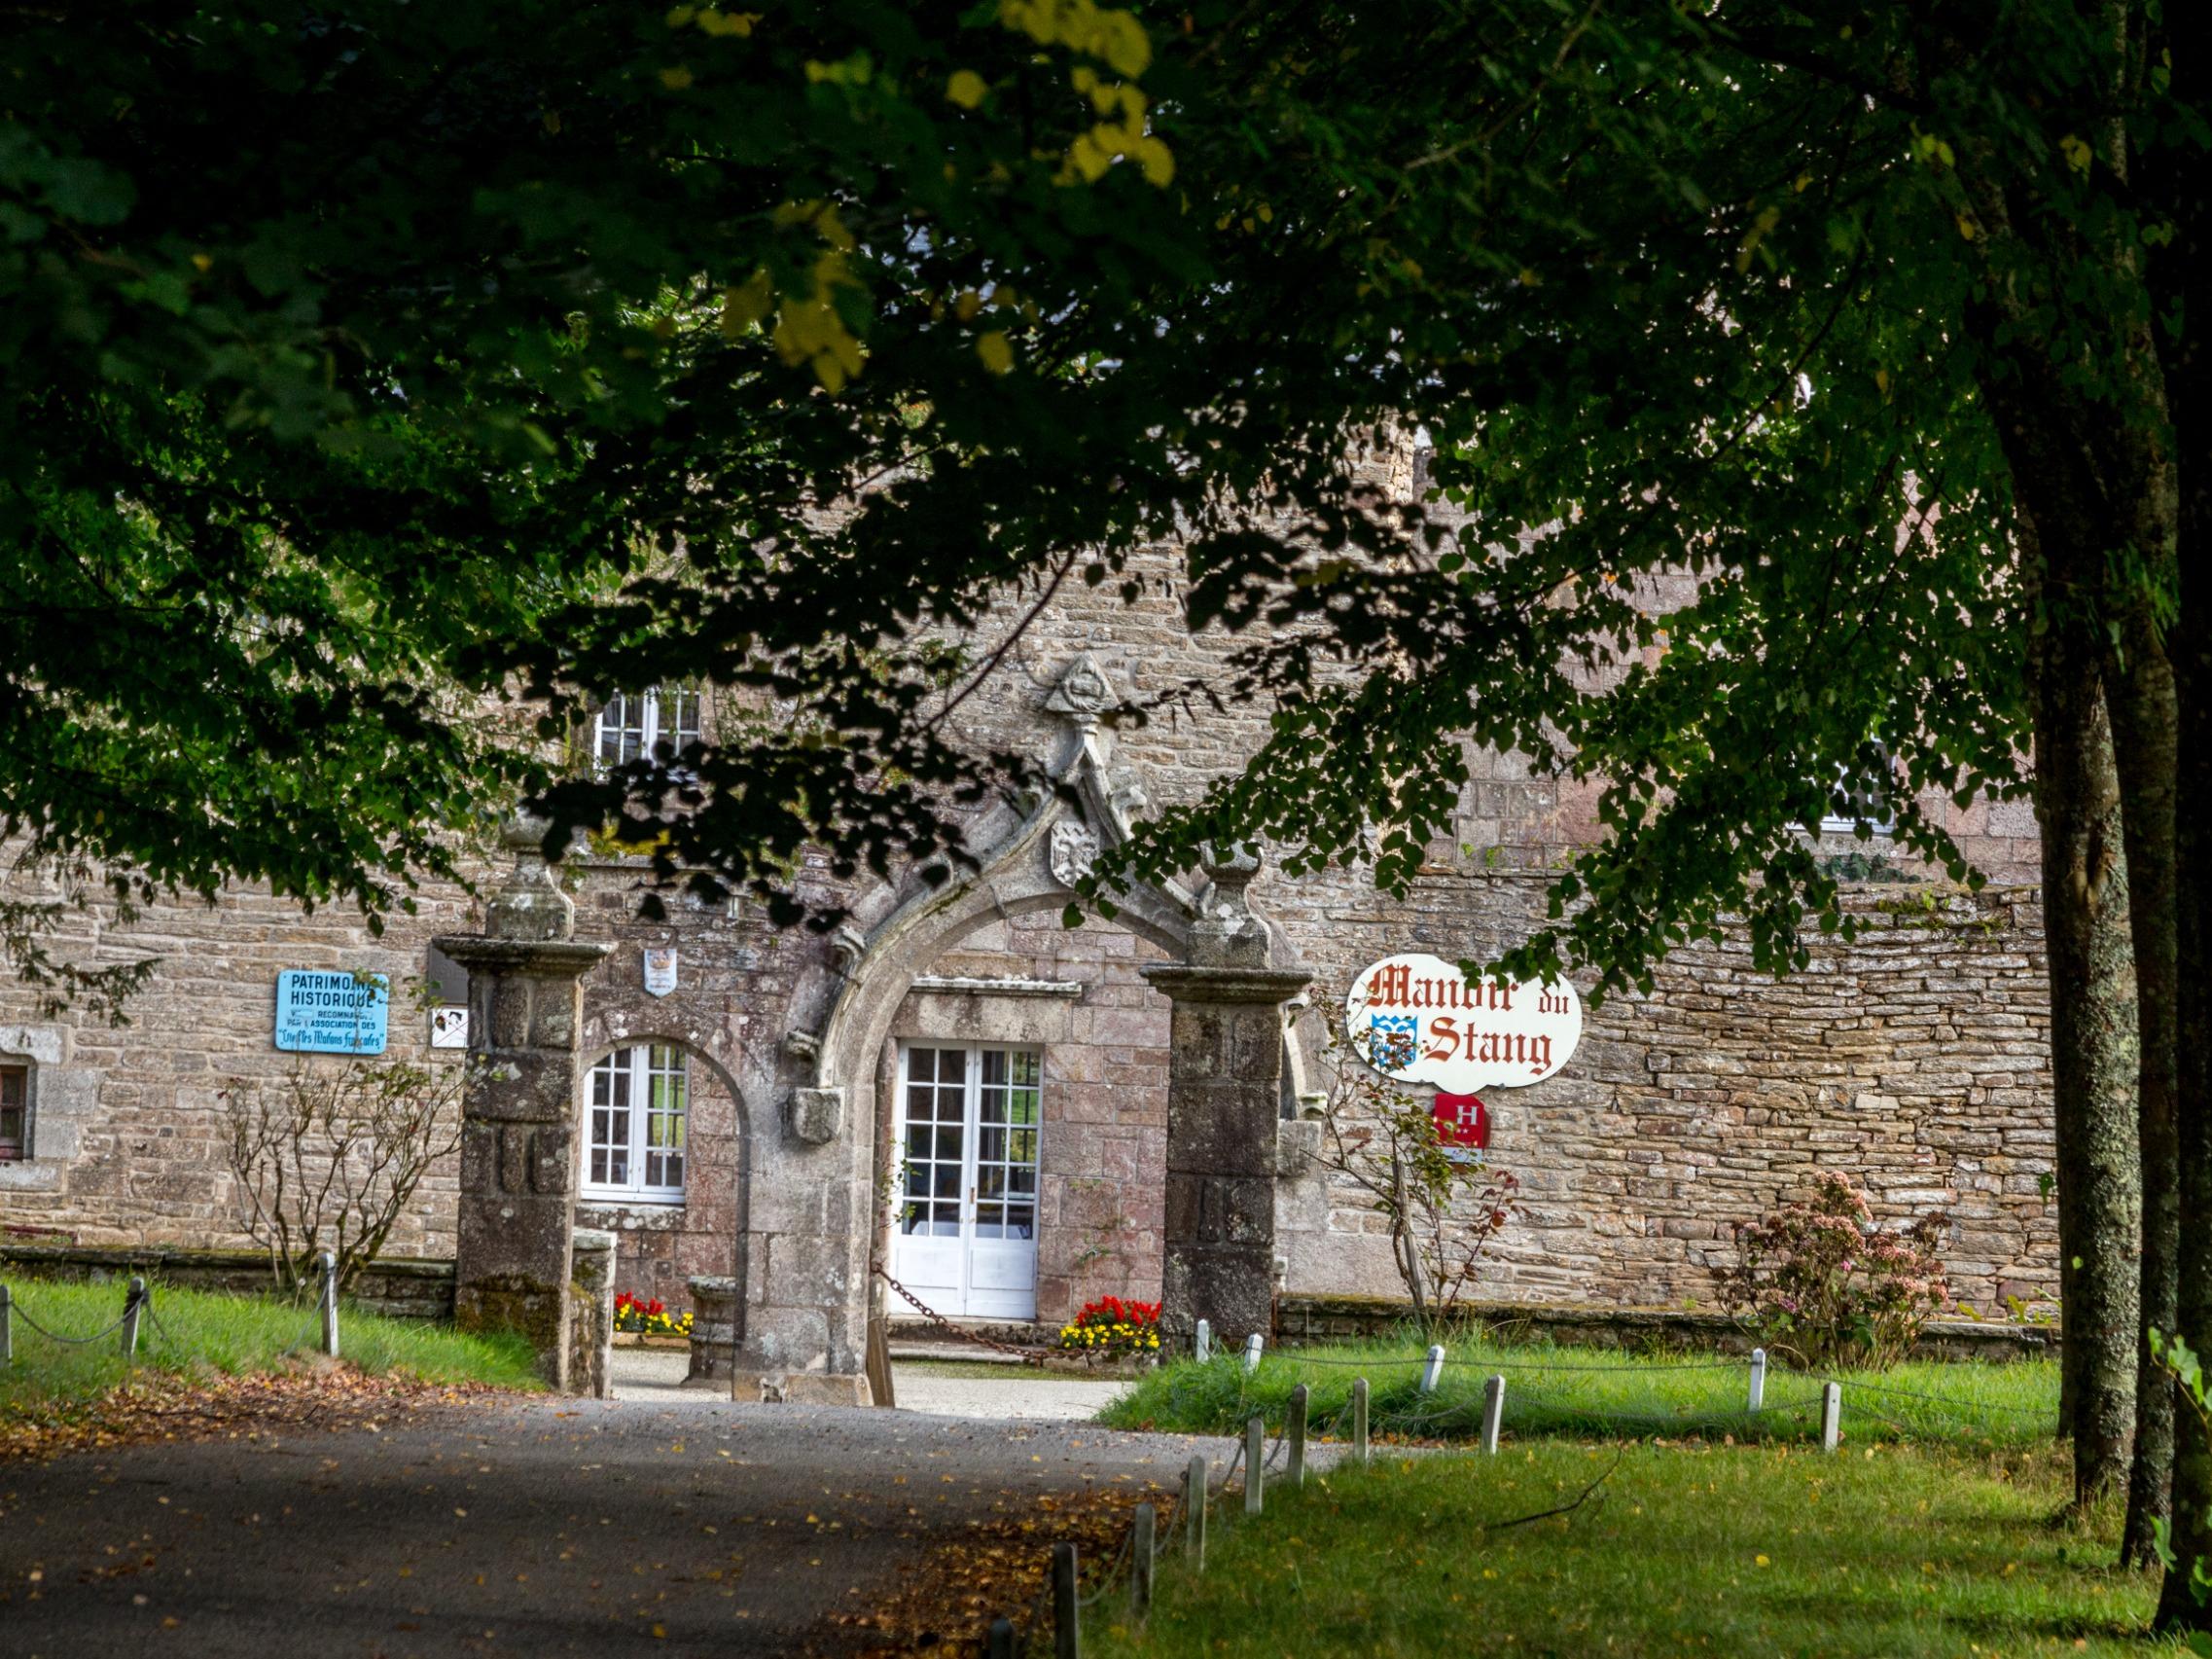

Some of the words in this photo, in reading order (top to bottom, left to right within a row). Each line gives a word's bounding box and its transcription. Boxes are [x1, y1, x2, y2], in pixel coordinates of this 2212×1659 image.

[292, 974, 374, 991] PATRIMOIN
[1367, 963, 1518, 1012] Manoir
[1538, 986, 1569, 1015] du
[291, 992, 374, 1008] HISTORIQUE
[361, 1022, 375, 1030] DES
[1424, 1017, 1552, 1076] Stang
[1455, 1105, 1479, 1126] H
